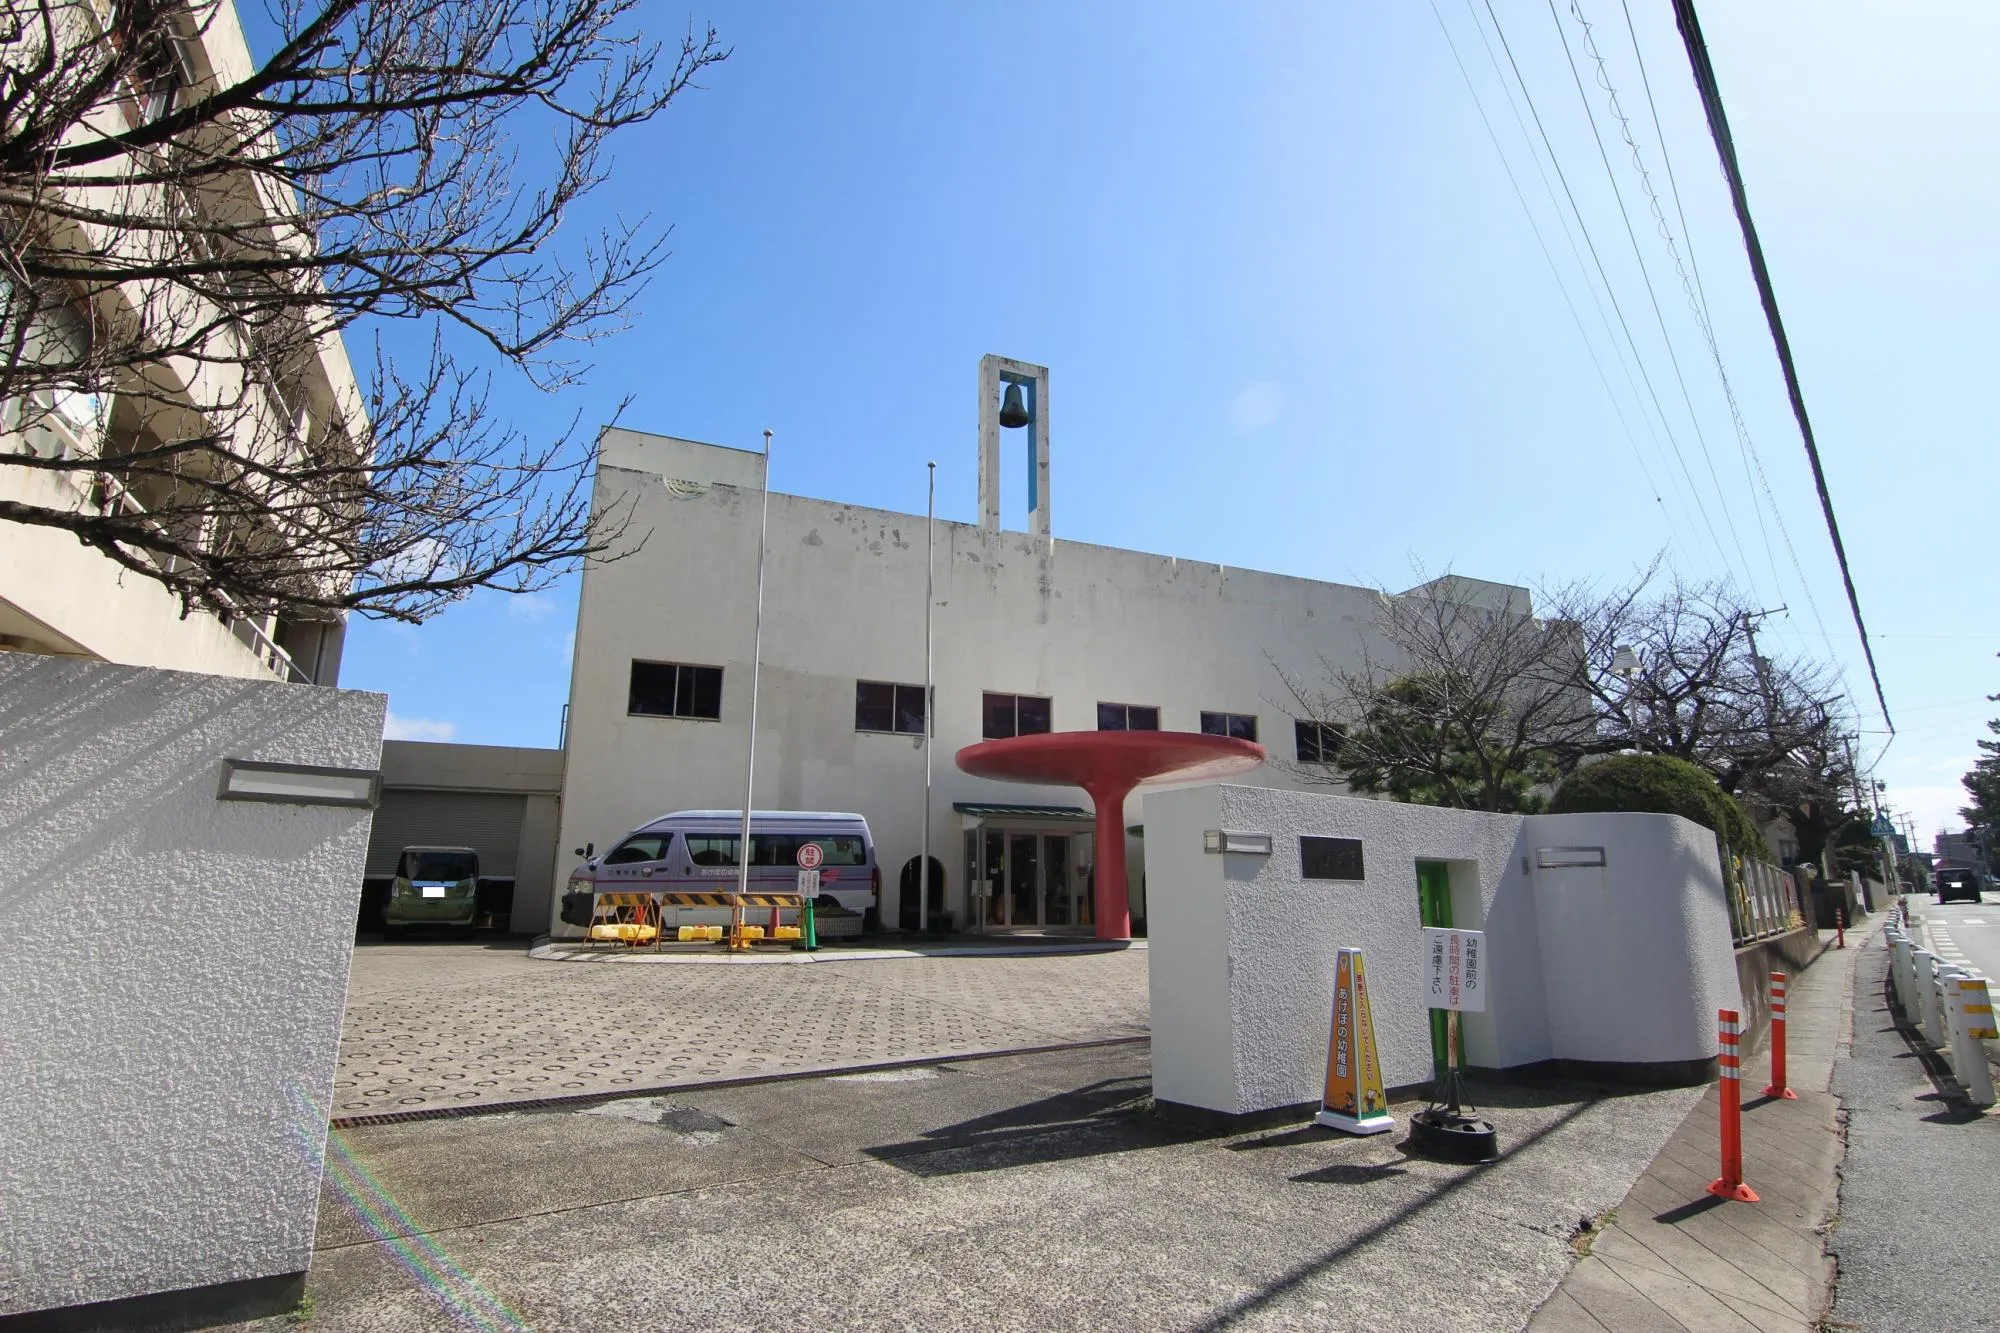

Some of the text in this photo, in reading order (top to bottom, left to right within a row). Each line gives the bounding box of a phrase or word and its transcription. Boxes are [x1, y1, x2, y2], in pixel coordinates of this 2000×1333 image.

[1431, 934, 1444, 994] ご遠慮下さい
[1448, 934, 1460, 1005] 長時間の駐車は
[1465, 937, 1478, 990] 幼稚園前の
